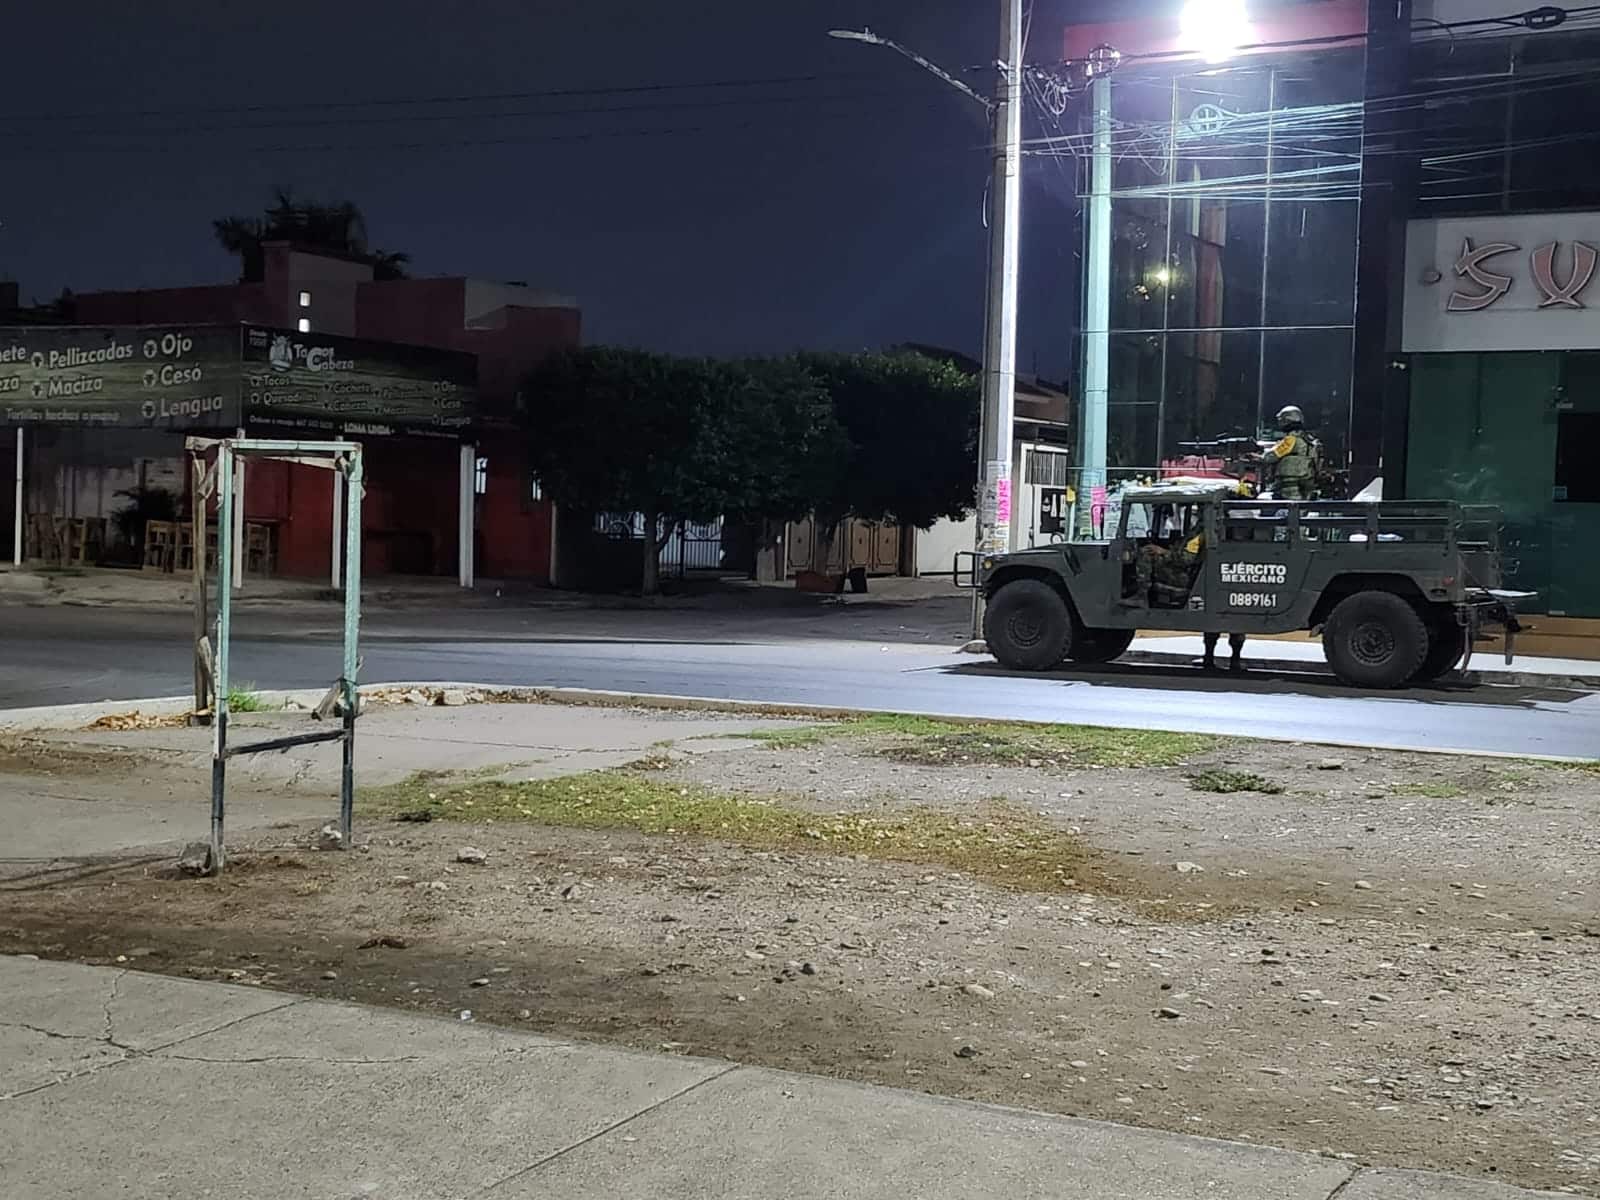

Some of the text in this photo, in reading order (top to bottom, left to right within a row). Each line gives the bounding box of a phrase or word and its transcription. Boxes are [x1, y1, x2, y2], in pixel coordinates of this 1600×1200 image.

[48, 340, 134, 369] Pellizcadas
[161, 333, 193, 358] Ojo
[160, 363, 203, 386] Cesó
[263, 375, 290, 386] Tacos
[47, 376, 103, 397] Maciza
[160, 395, 223, 418] Lengua
[1220, 561, 1287, 575] EJÉRCITO
[1221, 574, 1285, 584] MEXICANO
[1229, 593, 1277, 607] 0889161
